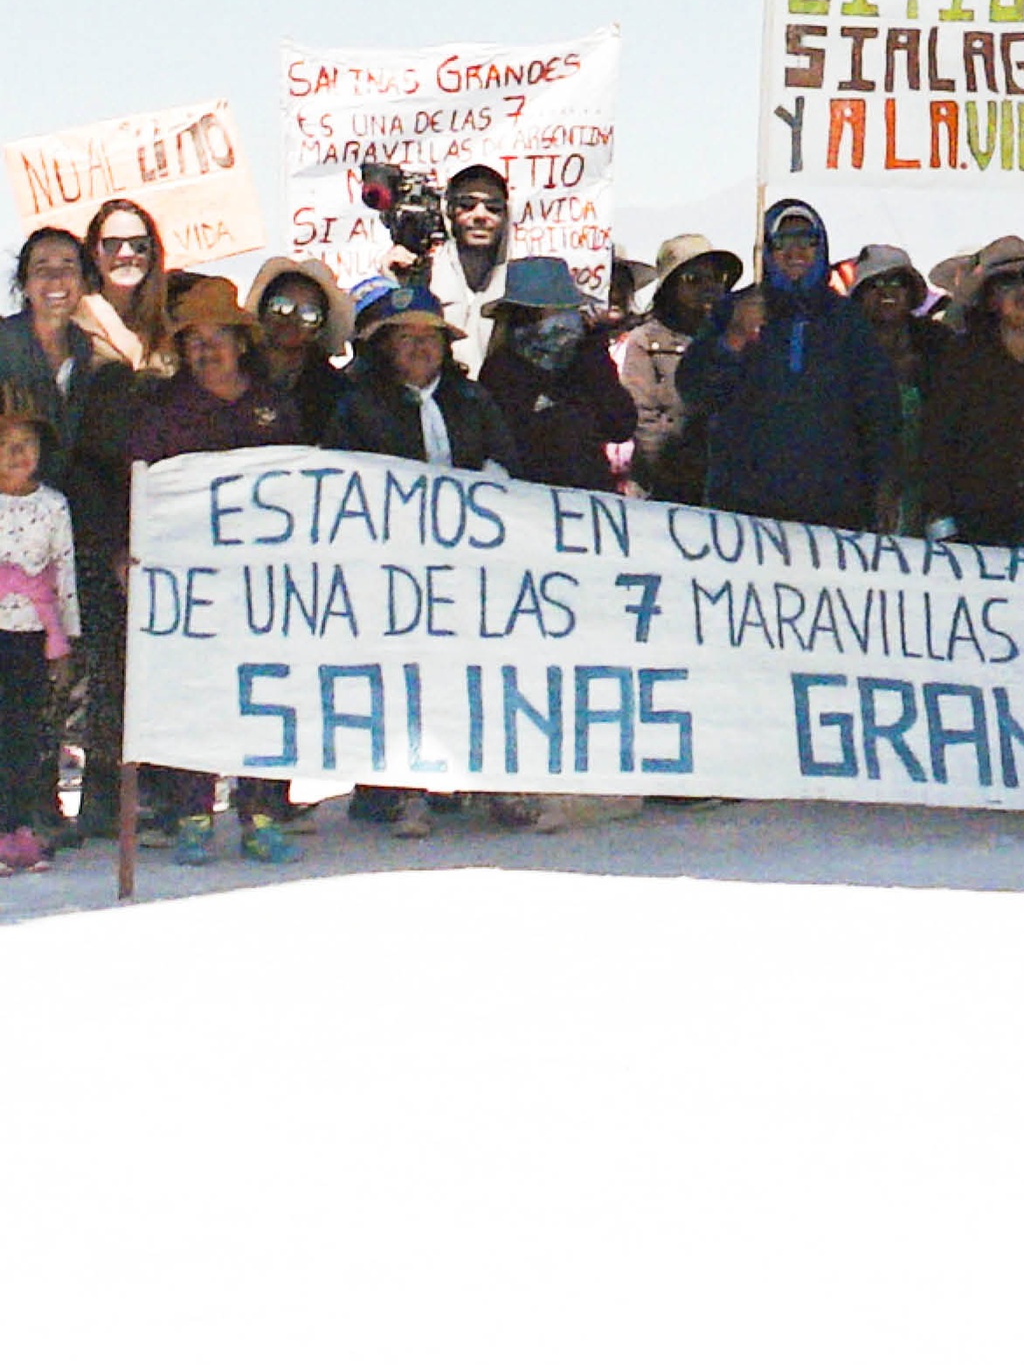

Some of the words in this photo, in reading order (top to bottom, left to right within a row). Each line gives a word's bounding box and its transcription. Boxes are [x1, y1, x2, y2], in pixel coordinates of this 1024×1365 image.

[436, 53, 581, 93] GRANDES
[352, 111, 403, 137] UNA
[502, 95, 526, 124] 7
[774, 95, 805, 173] Y
[301, 138, 474, 165] MARAVILLAS
[499, 153, 585, 191] ITIO
[293, 207, 339, 245] SI
[209, 468, 508, 549] ESTAMOS
[552, 487, 631, 556] EN
[142, 567, 217, 638] DE
[243, 563, 358, 637] UNA
[383, 565, 456, 637] DE
[480, 568, 579, 638] LAS
[614, 573, 662, 642] 7
[691, 577, 1019, 663] MARAVILLAS
[237, 664, 693, 773] SALINAS
